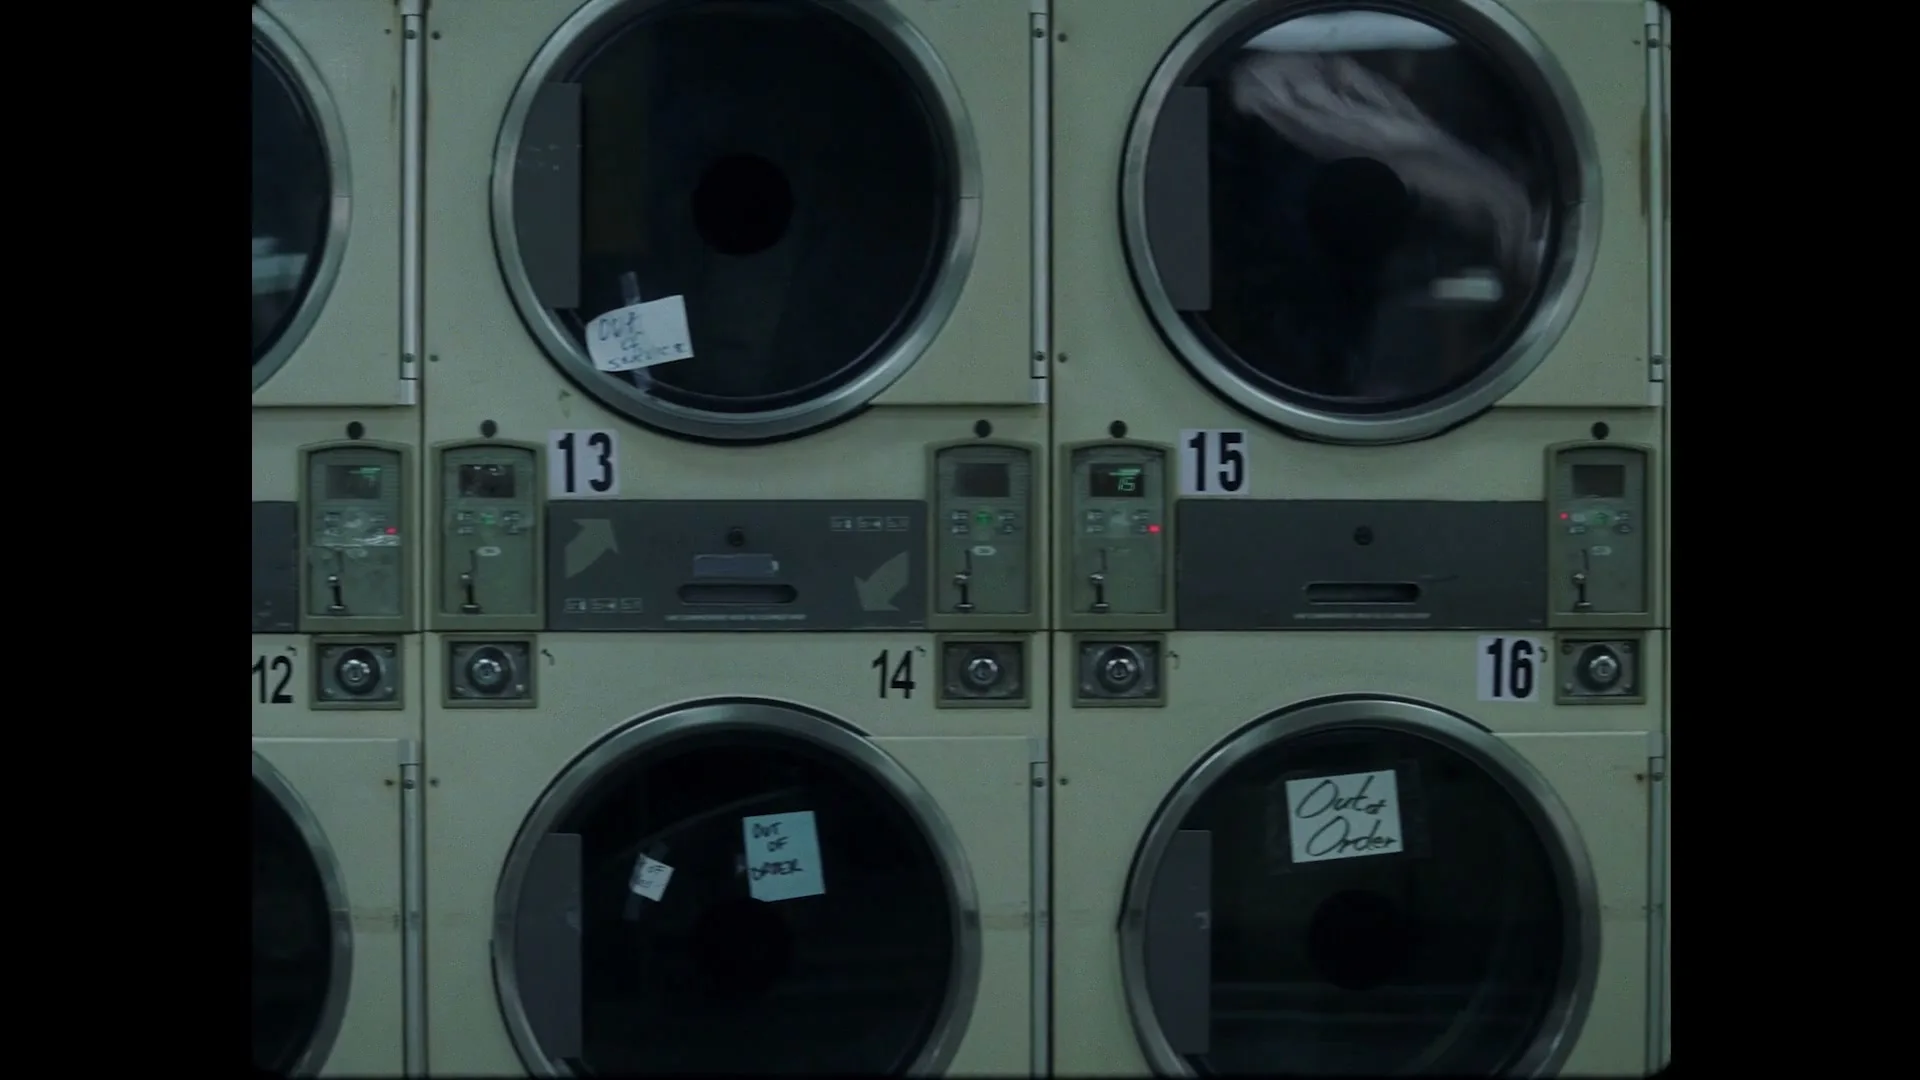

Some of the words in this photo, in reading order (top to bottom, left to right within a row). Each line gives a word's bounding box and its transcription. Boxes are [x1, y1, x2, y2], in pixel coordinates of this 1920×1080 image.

[557, 432, 613, 493] 13
[1190, 432, 1244, 491] 15
[252, 655, 294, 704] 12
[872, 649, 915, 699] 14
[1486, 637, 1535, 699] 16
[1295, 775, 1374, 820] Out
[751, 822, 782, 839] OUT
[766, 836, 788, 852] OF
[1305, 815, 1398, 857] Order
